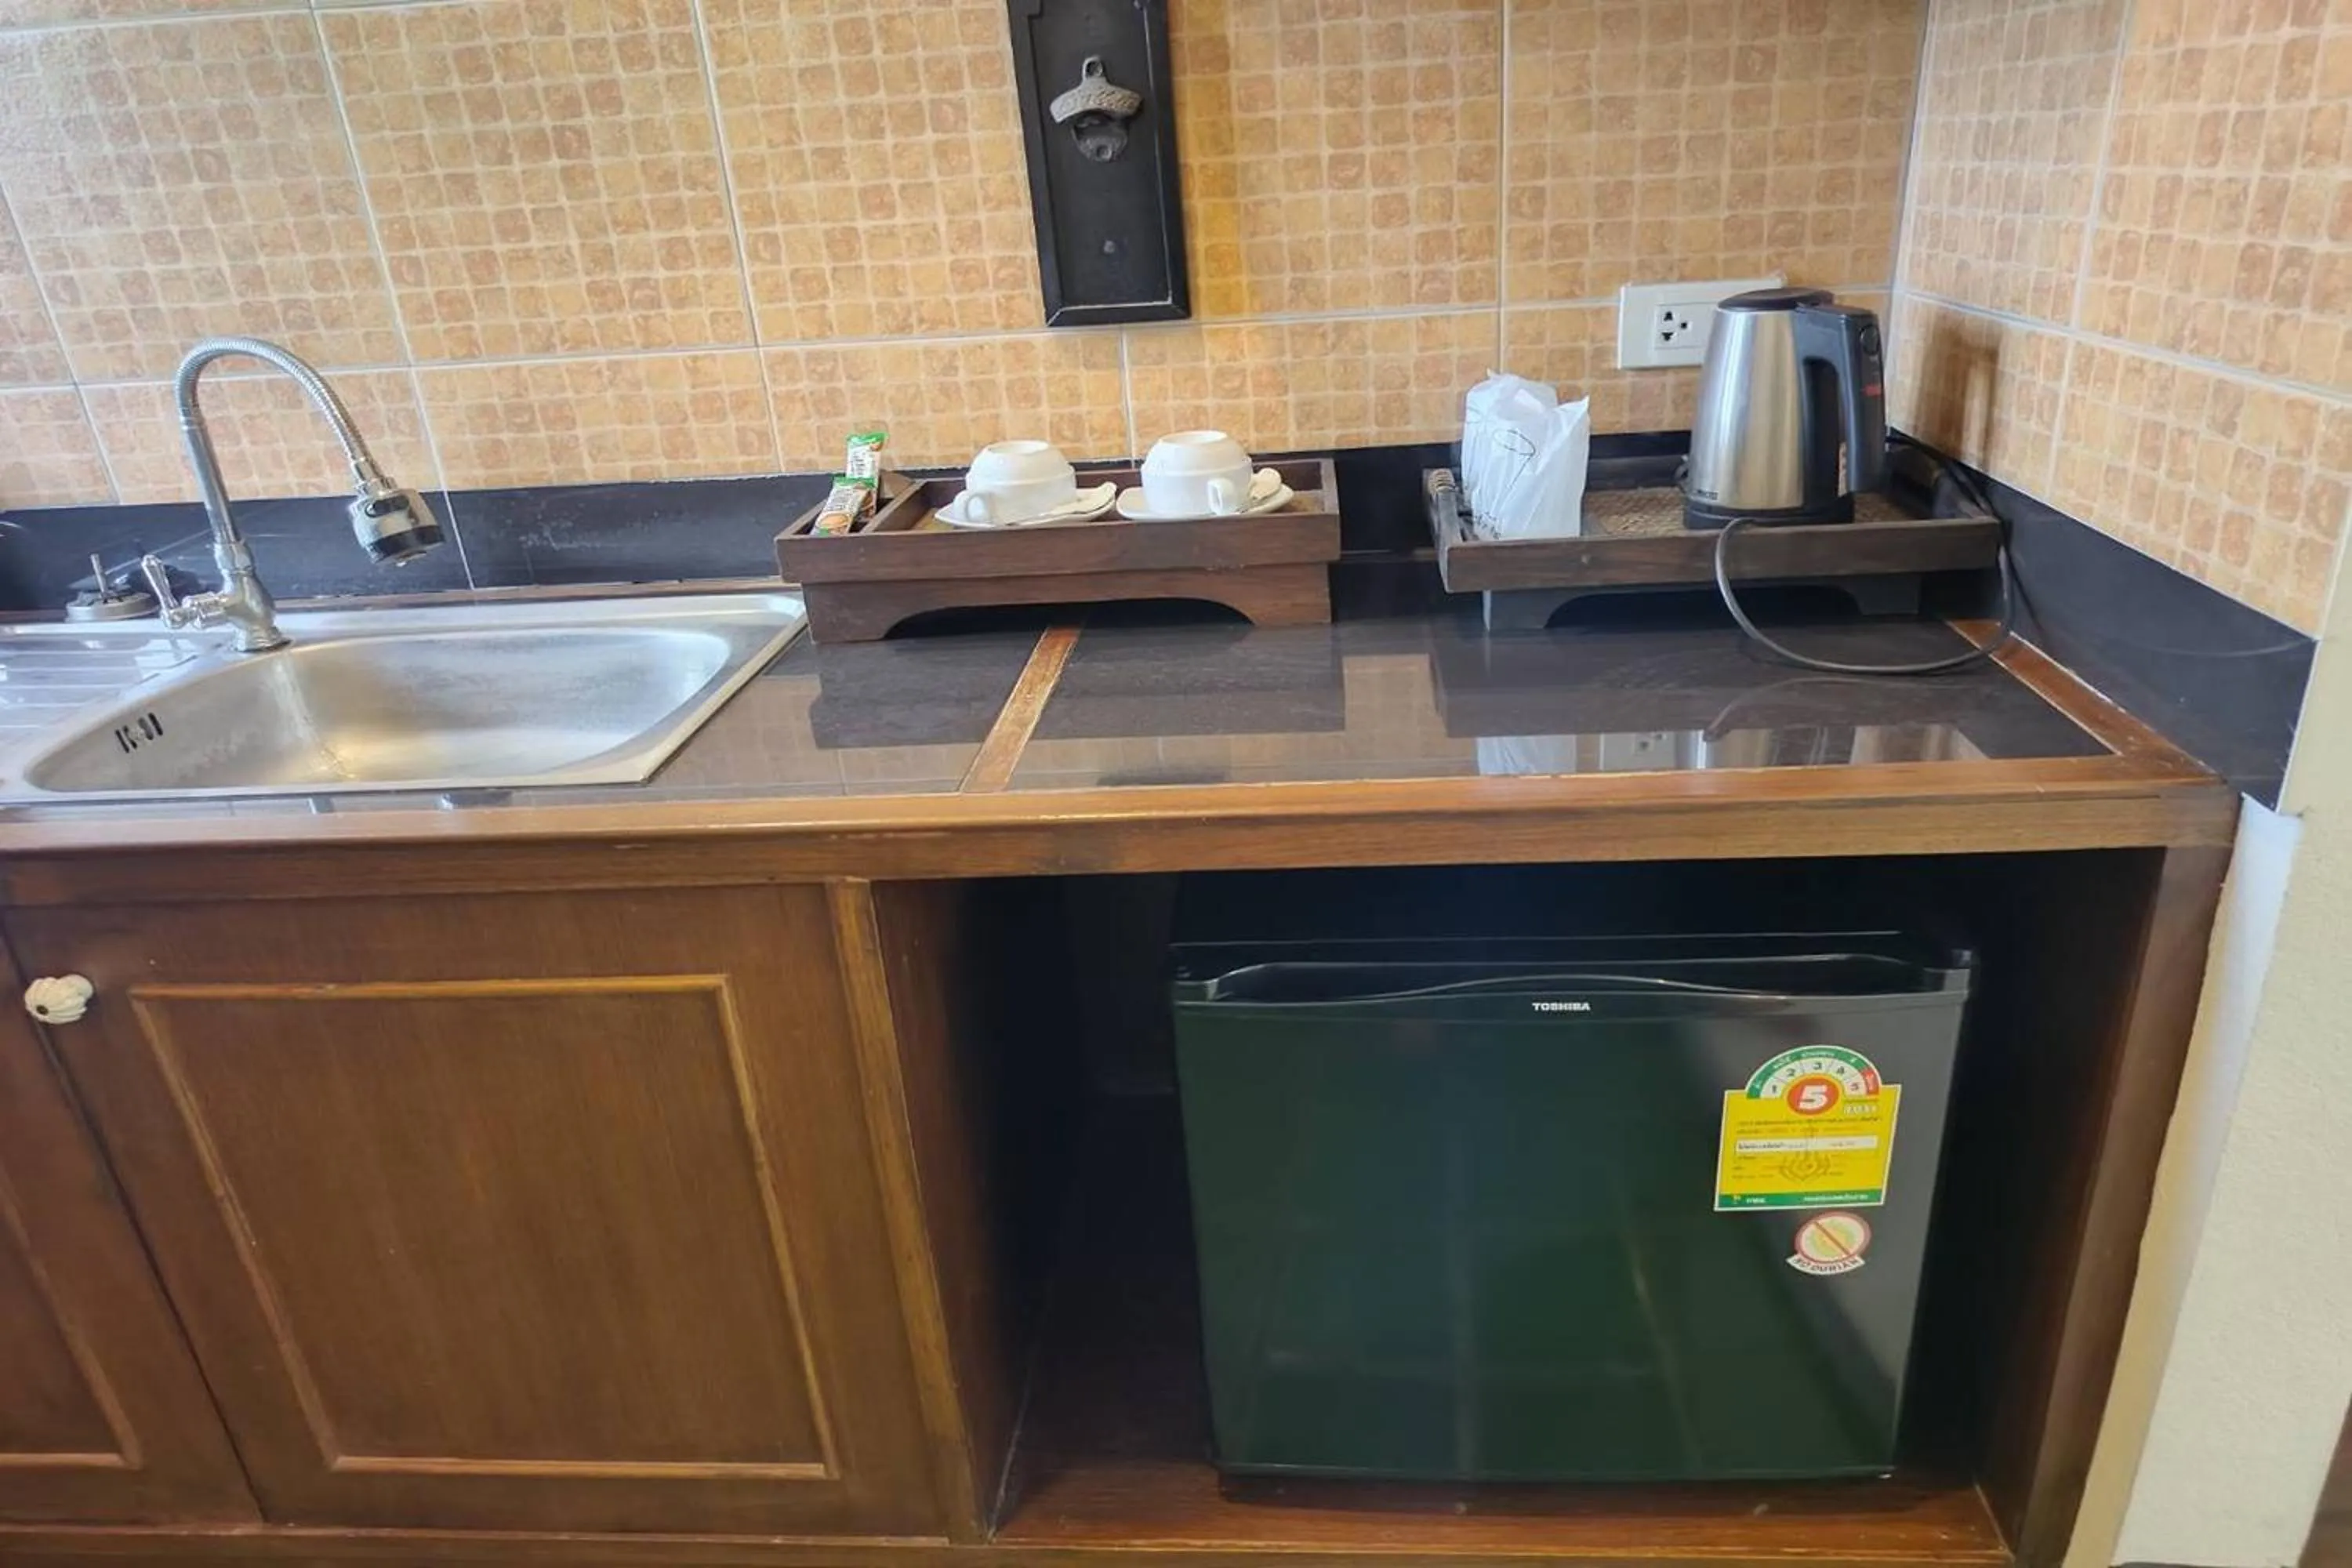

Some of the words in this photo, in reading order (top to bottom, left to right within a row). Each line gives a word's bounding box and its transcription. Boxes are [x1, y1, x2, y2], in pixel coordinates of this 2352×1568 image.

[1531, 1002, 1591, 1011] TOSHIBA
[1798, 1084, 1828, 1110] 5
[1811, 1258, 1859, 1272] DURIAN
